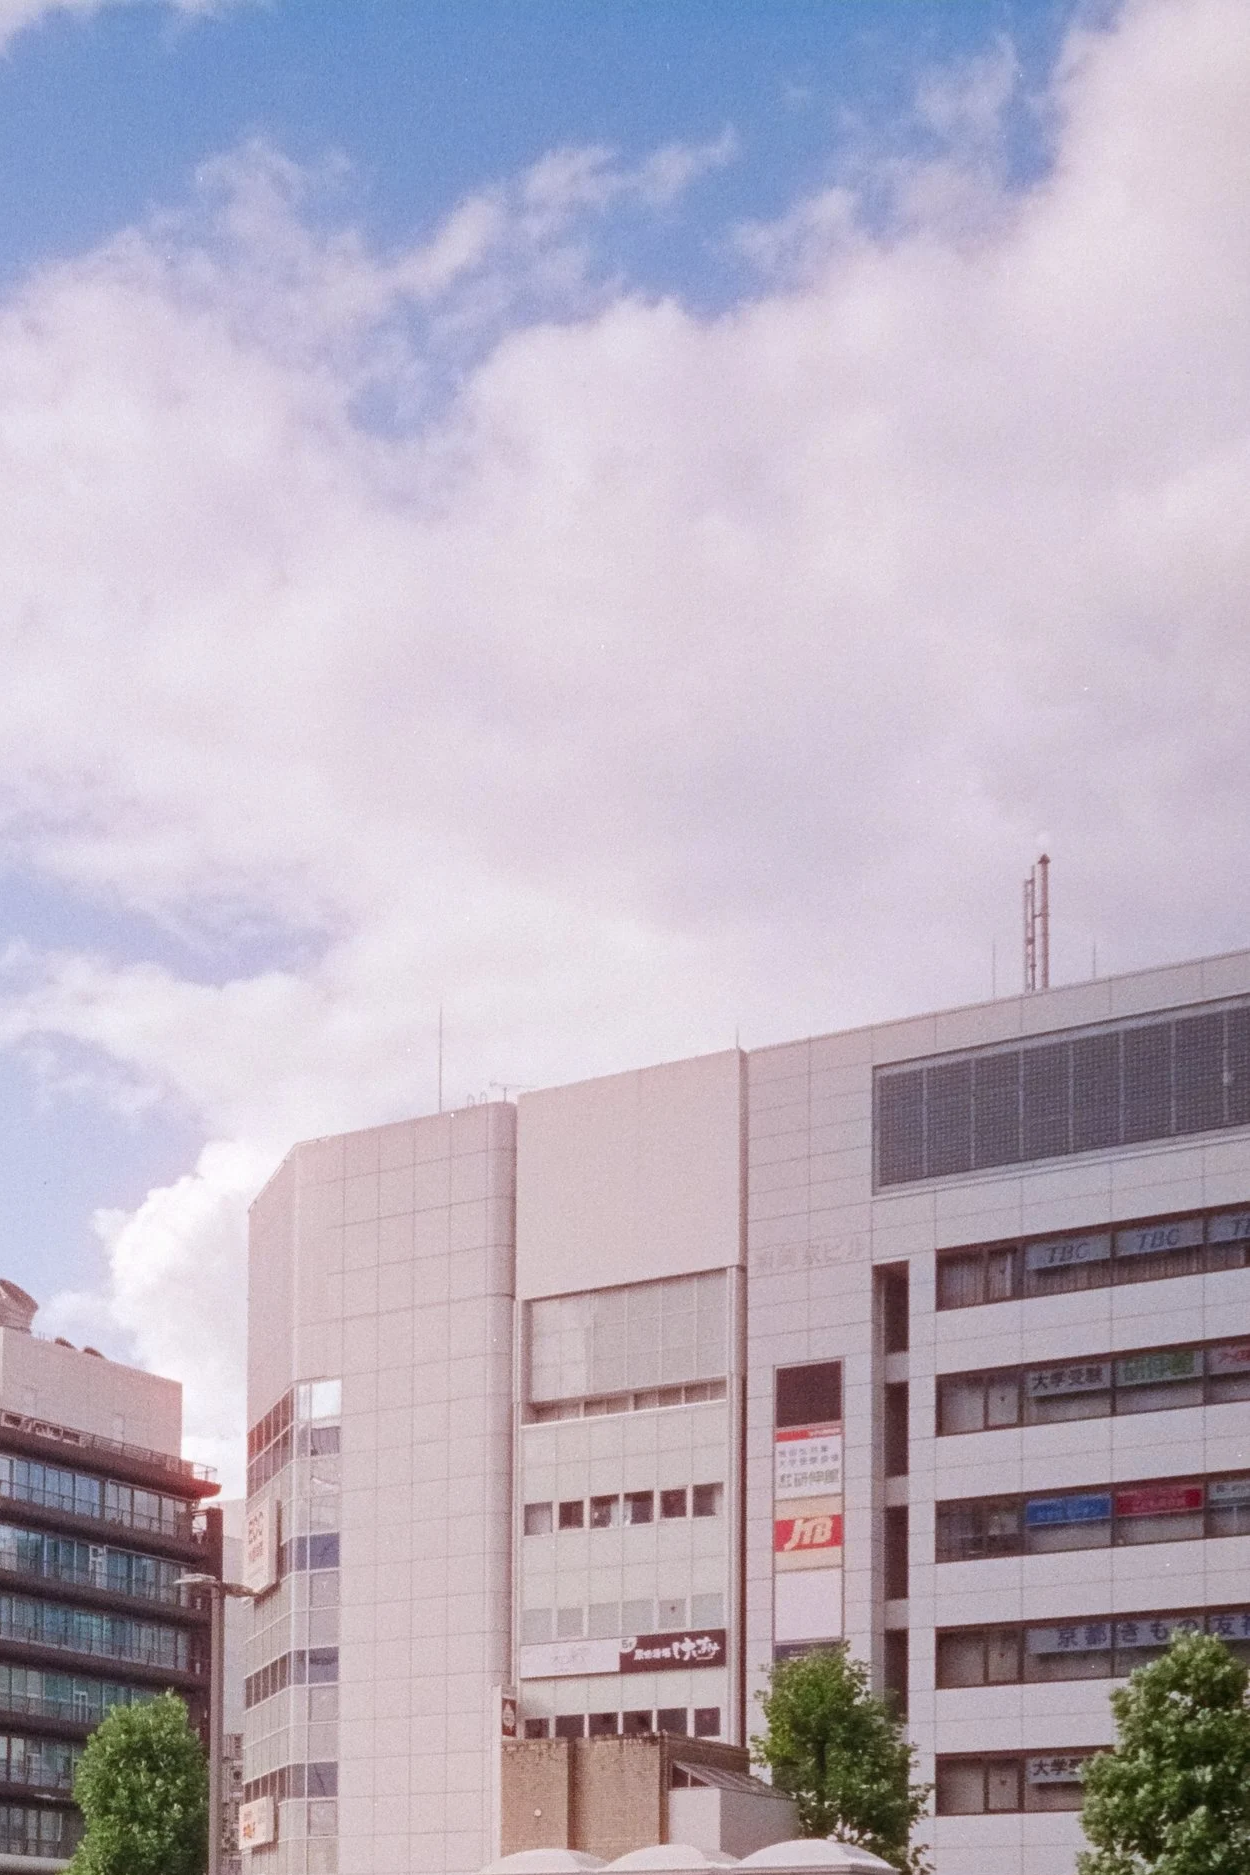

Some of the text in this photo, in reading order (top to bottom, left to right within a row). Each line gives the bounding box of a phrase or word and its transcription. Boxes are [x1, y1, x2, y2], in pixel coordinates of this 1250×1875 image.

[1137, 1227, 1181, 1250] TBC
[1046, 1242, 1090, 1264] TBC
[783, 1516, 834, 1551] JTB
